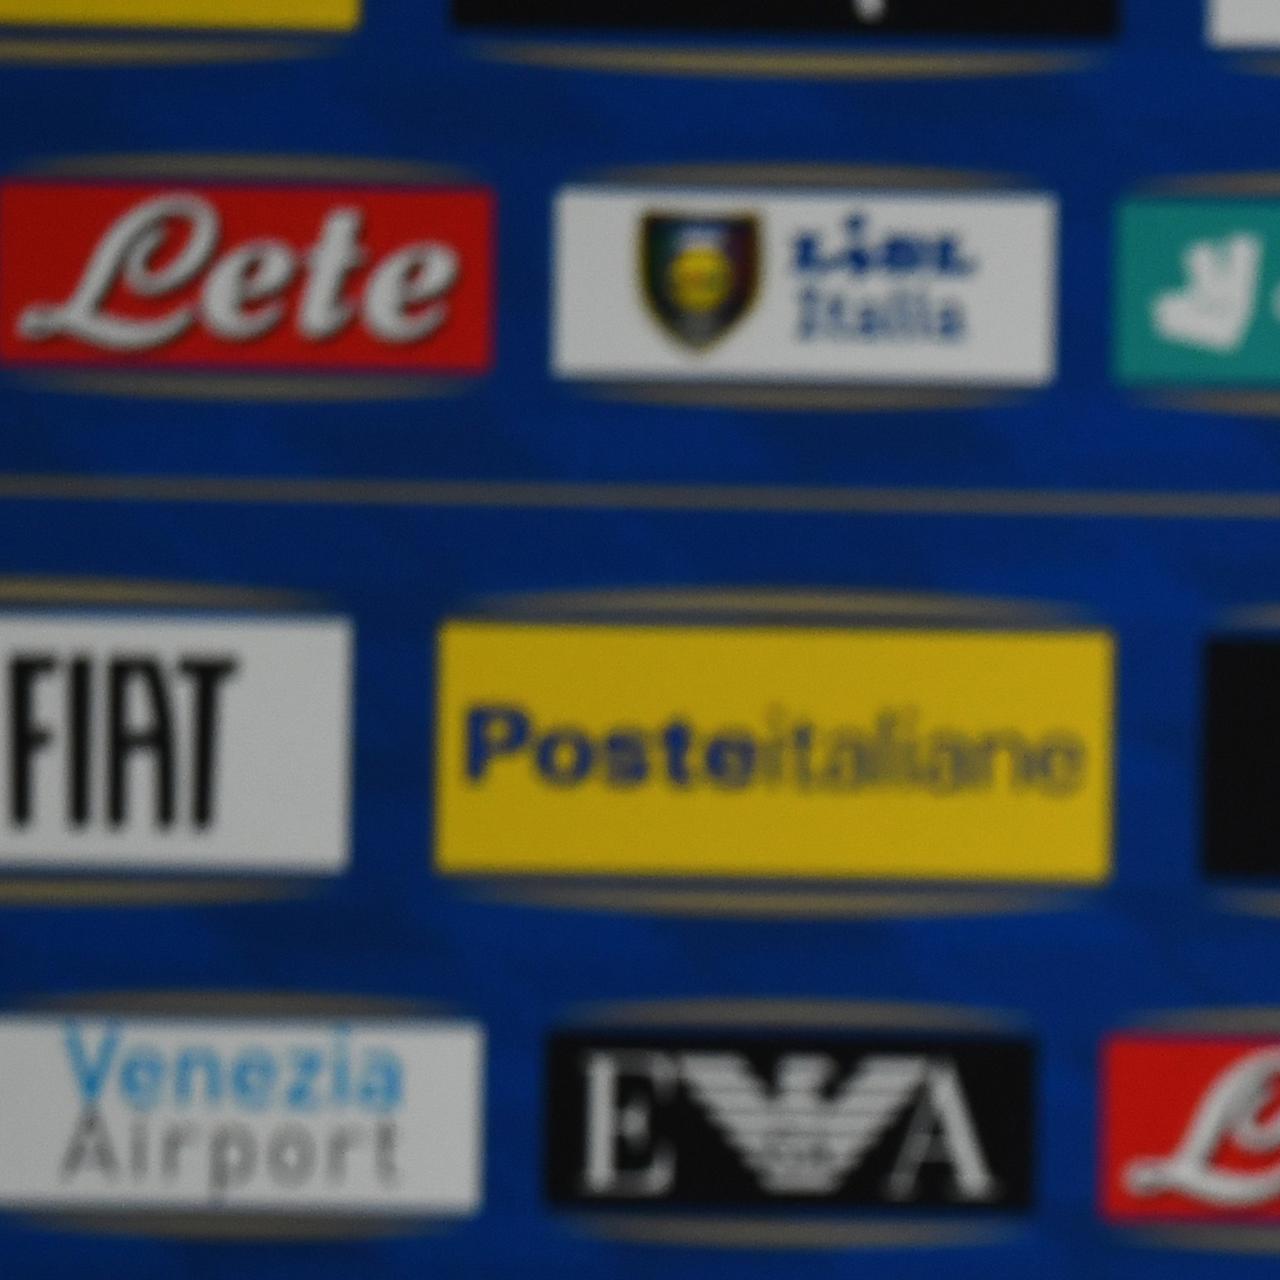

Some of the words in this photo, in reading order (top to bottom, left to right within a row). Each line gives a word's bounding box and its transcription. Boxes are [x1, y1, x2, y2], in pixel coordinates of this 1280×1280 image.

[16, 194, 458, 352] Lete
[798, 287, 964, 341] Italia
[8, 652, 238, 832] FIAT
[62, 1020, 406, 1112] Venezia
[60, 1106, 404, 1197] Airport
